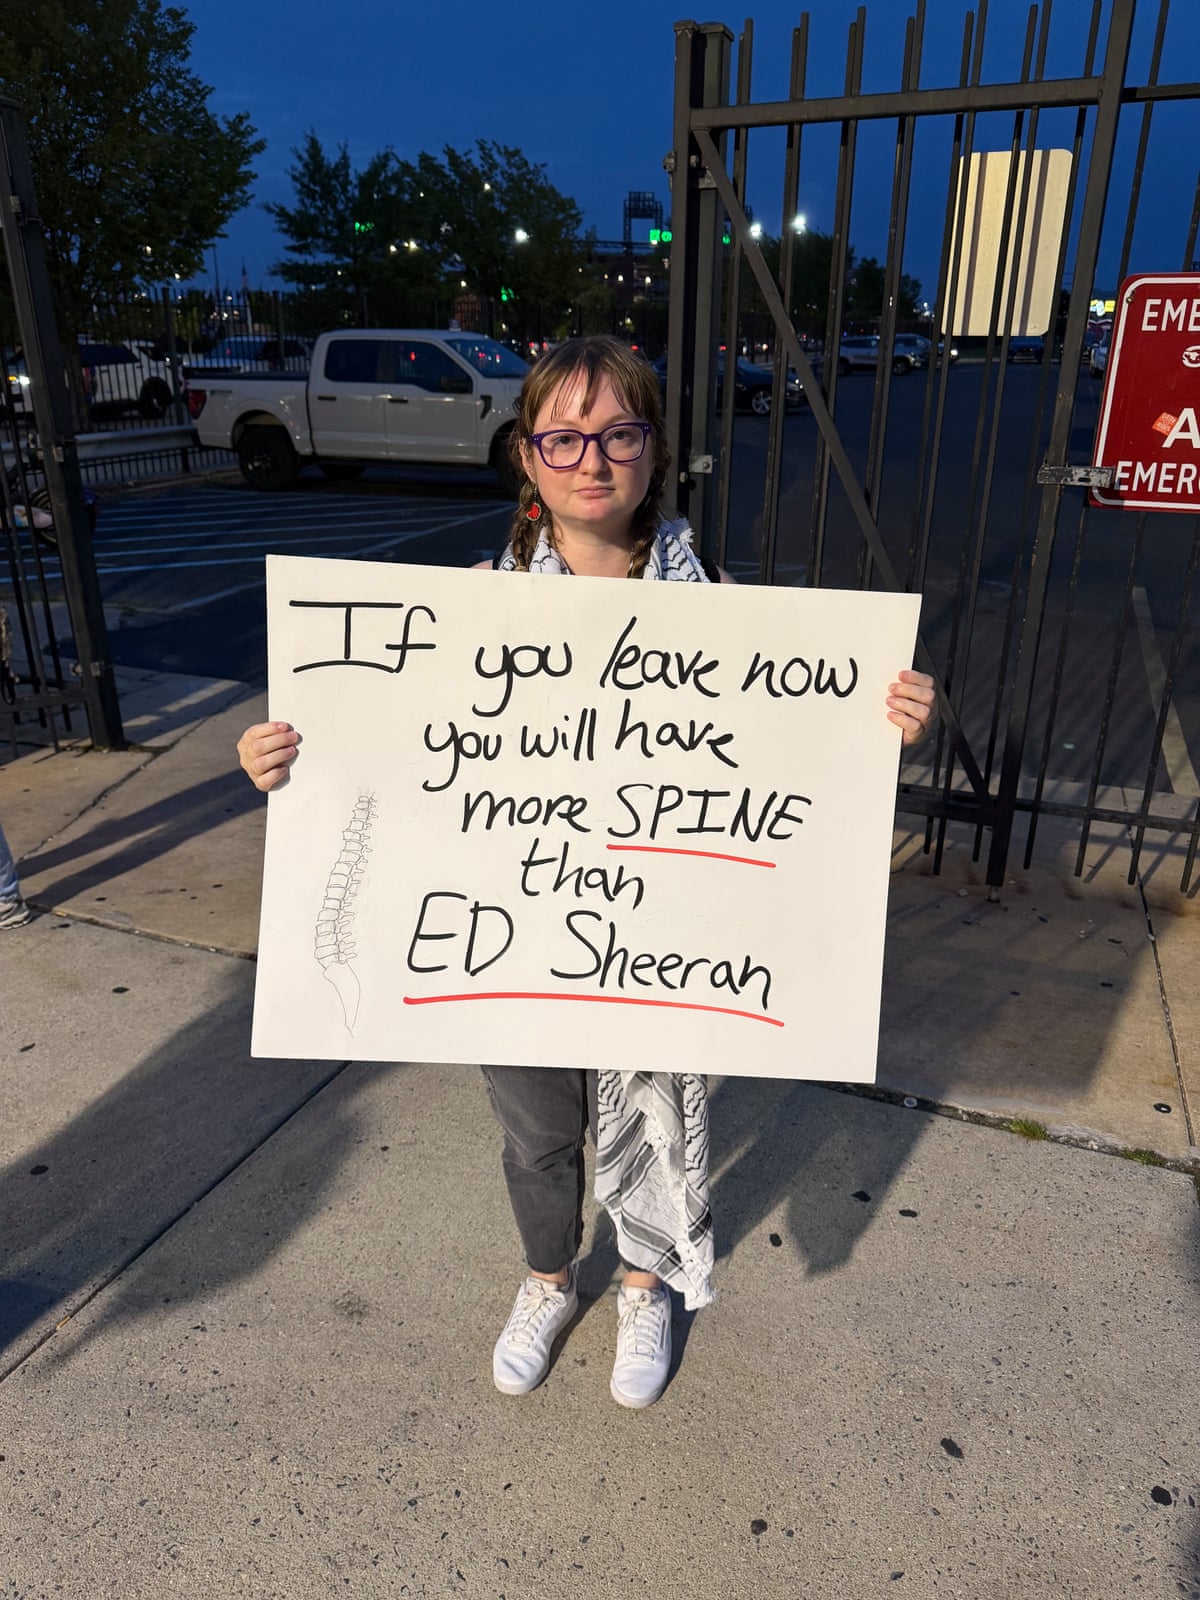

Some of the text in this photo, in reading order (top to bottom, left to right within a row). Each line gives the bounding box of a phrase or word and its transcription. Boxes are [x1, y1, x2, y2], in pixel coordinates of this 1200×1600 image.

[1114, 460, 1200, 494] EMER
[288, 599, 858, 718] If you leave now
[422, 698, 739, 793] you will have
[461, 783, 812, 843] more SPINE
[520, 837, 645, 910] than
[406, 891, 772, 1011] ED Sheeran
